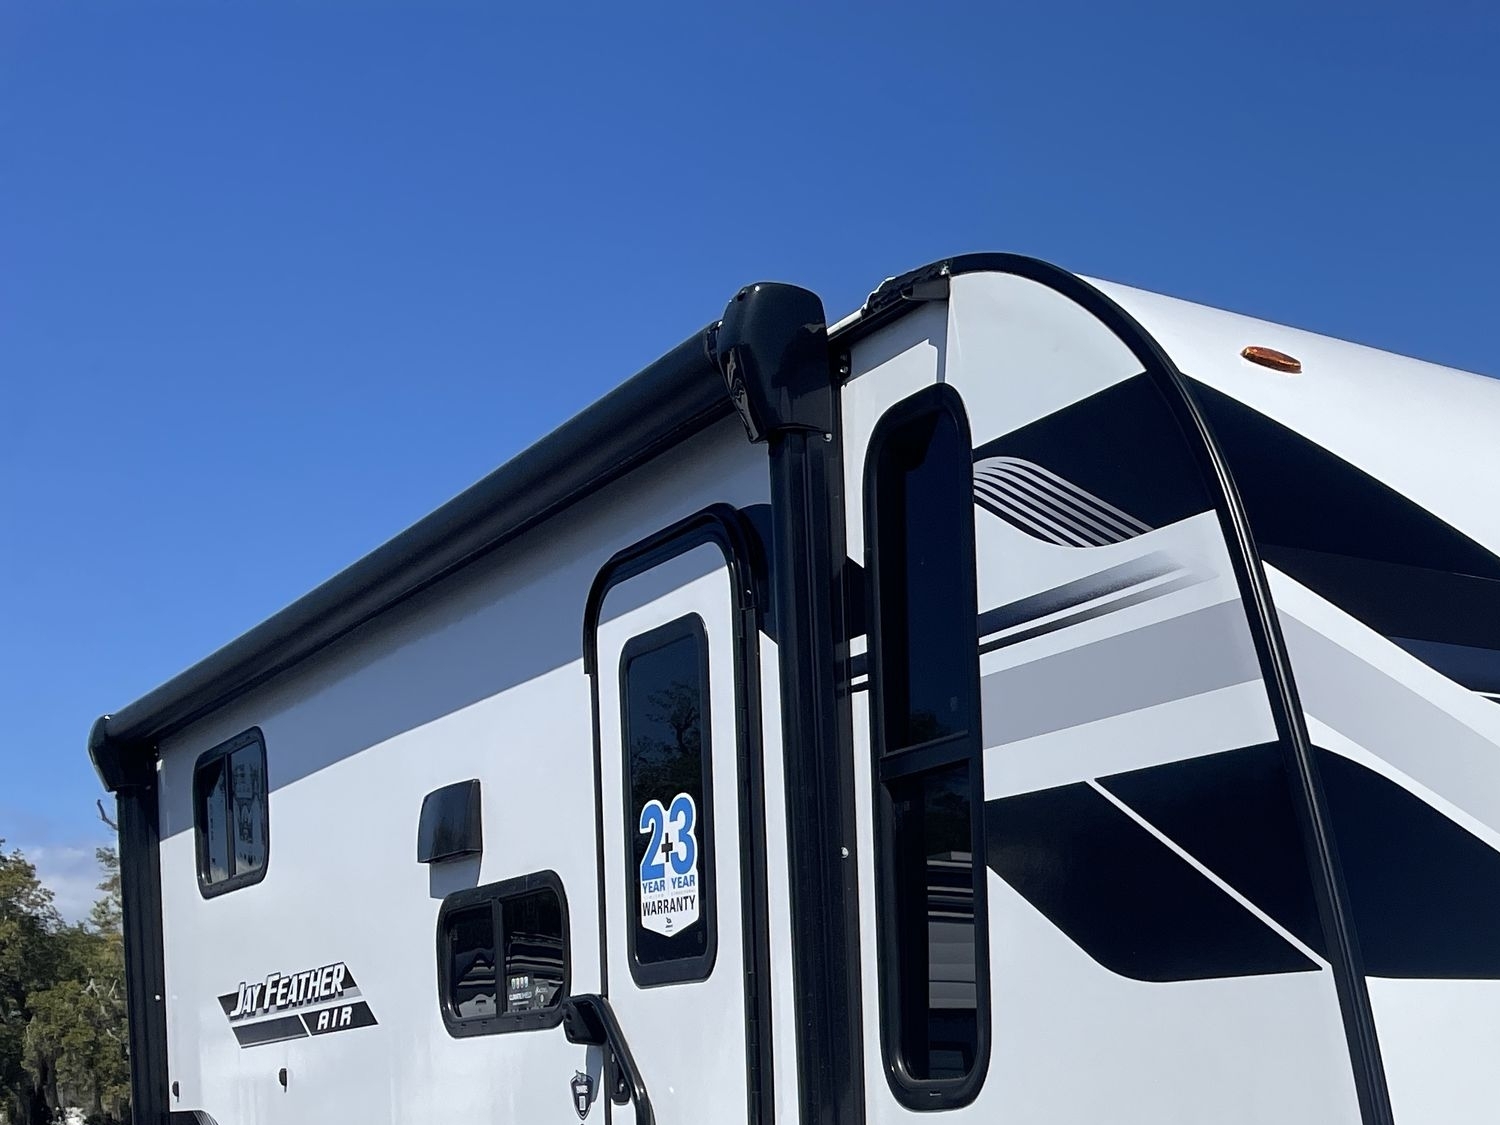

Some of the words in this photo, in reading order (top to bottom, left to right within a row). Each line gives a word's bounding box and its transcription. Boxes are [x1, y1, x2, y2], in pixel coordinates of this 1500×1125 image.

[642, 879, 666, 894] YEAR
[670, 874, 696, 889] YEAR
[642, 894, 696, 917] WARRANTY
[229, 982, 262, 1017] JAY
[262, 963, 346, 1010] FEATHER
[316, 1006, 353, 1031] AIR
